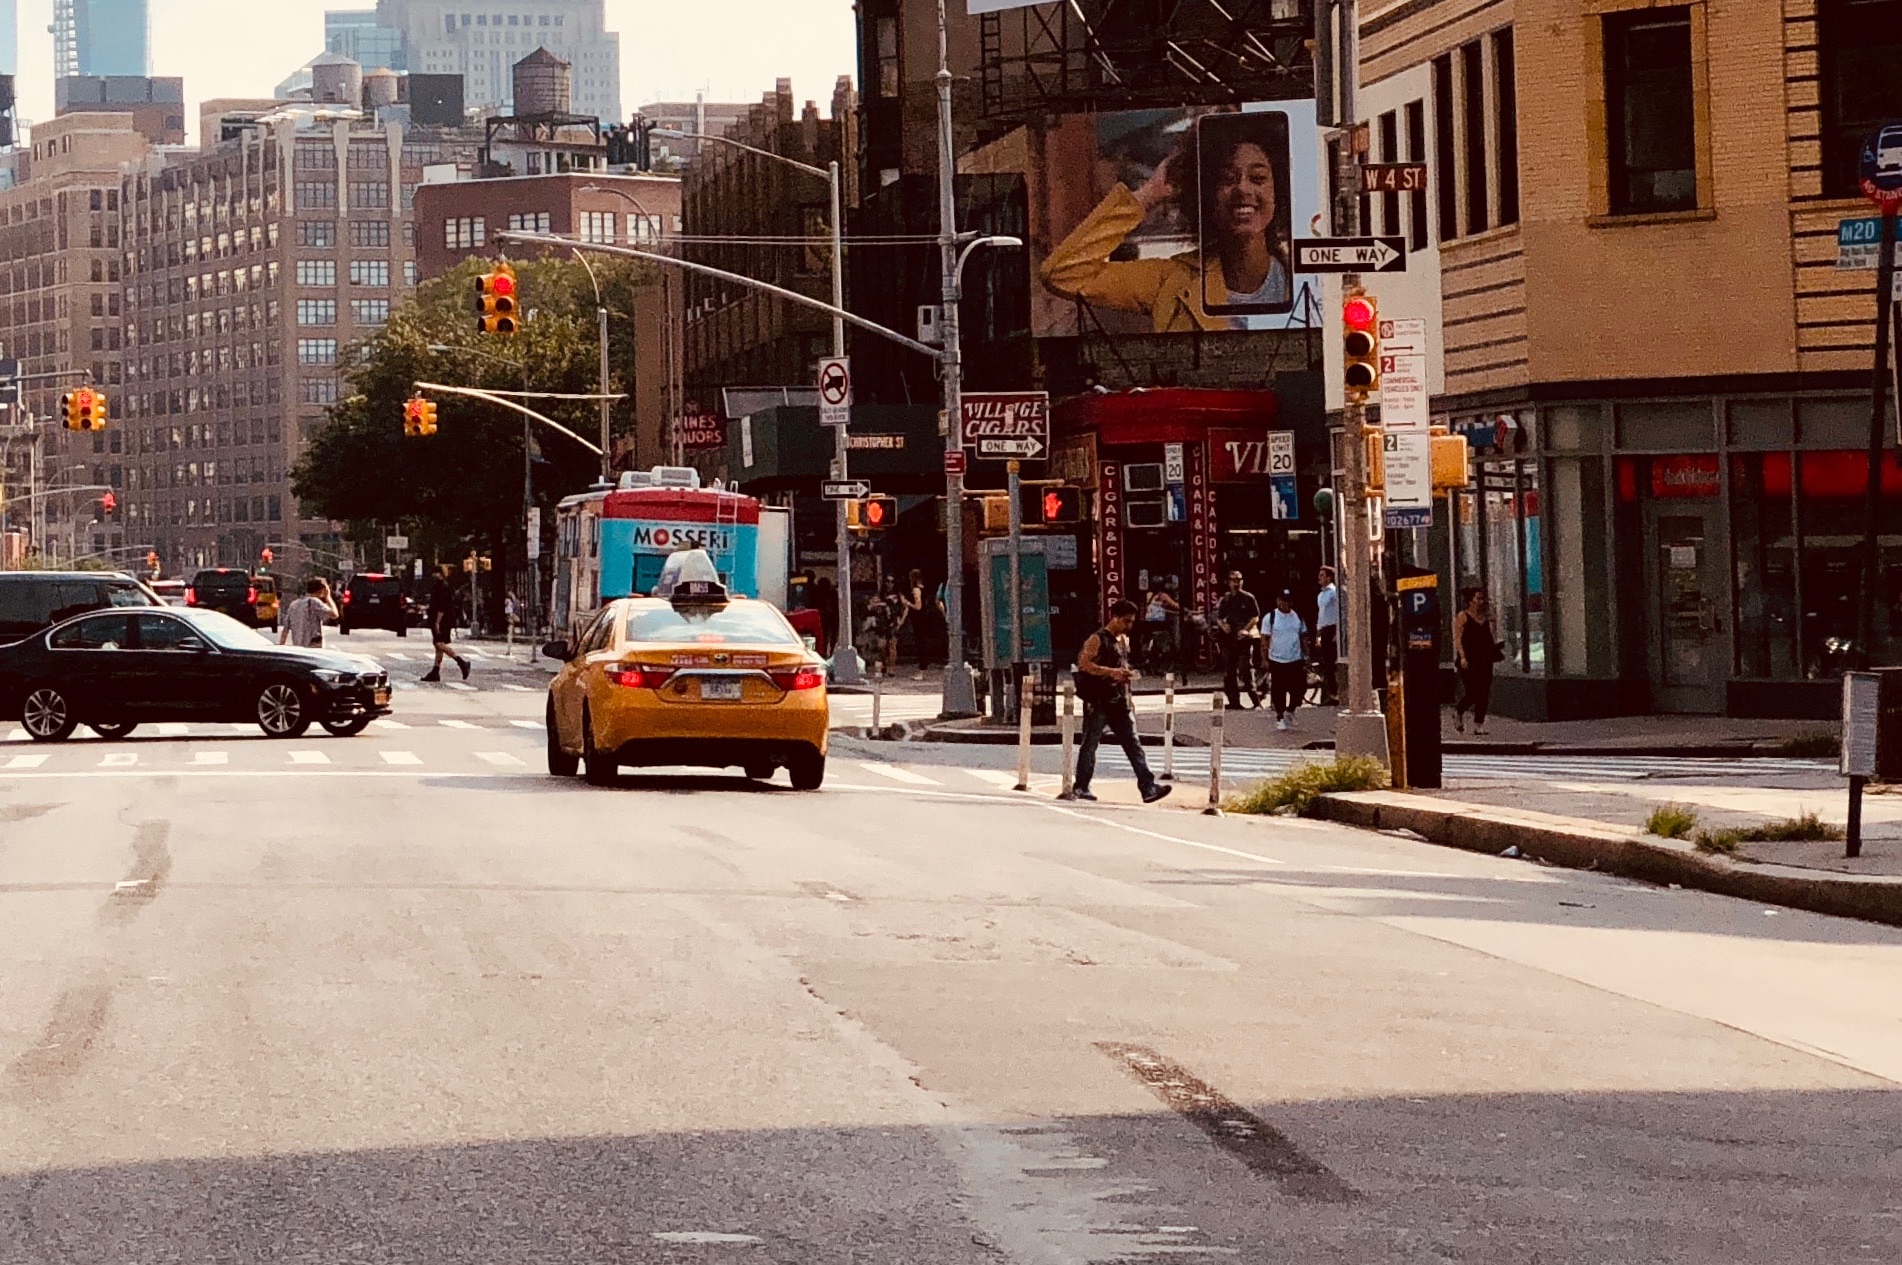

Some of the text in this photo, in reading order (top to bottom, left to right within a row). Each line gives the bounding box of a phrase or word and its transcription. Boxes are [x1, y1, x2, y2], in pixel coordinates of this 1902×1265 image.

[1366, 167, 1422, 190] W 4 ST
[1309, 248, 1389, 262] ONE WAY
[1384, 357, 1392, 372] 2
[849, 436, 894, 449] CHRISTOPHER
[985, 440, 1038, 452] ONE WAY
[1270, 435, 1291, 444] SPEED
[1387, 436, 1395, 451] 2
[1271, 443, 1290, 453] LIMIT
[1224, 441, 1271, 474] VI
[1273, 454, 1292, 470] 20
[1168, 463, 1182, 478] 20
[847, 485, 863, 493] WAY
[1208, 491, 1217, 563] CANDY
[1387, 515, 1420, 526] 102677
[1413, 592, 1427, 612] P
